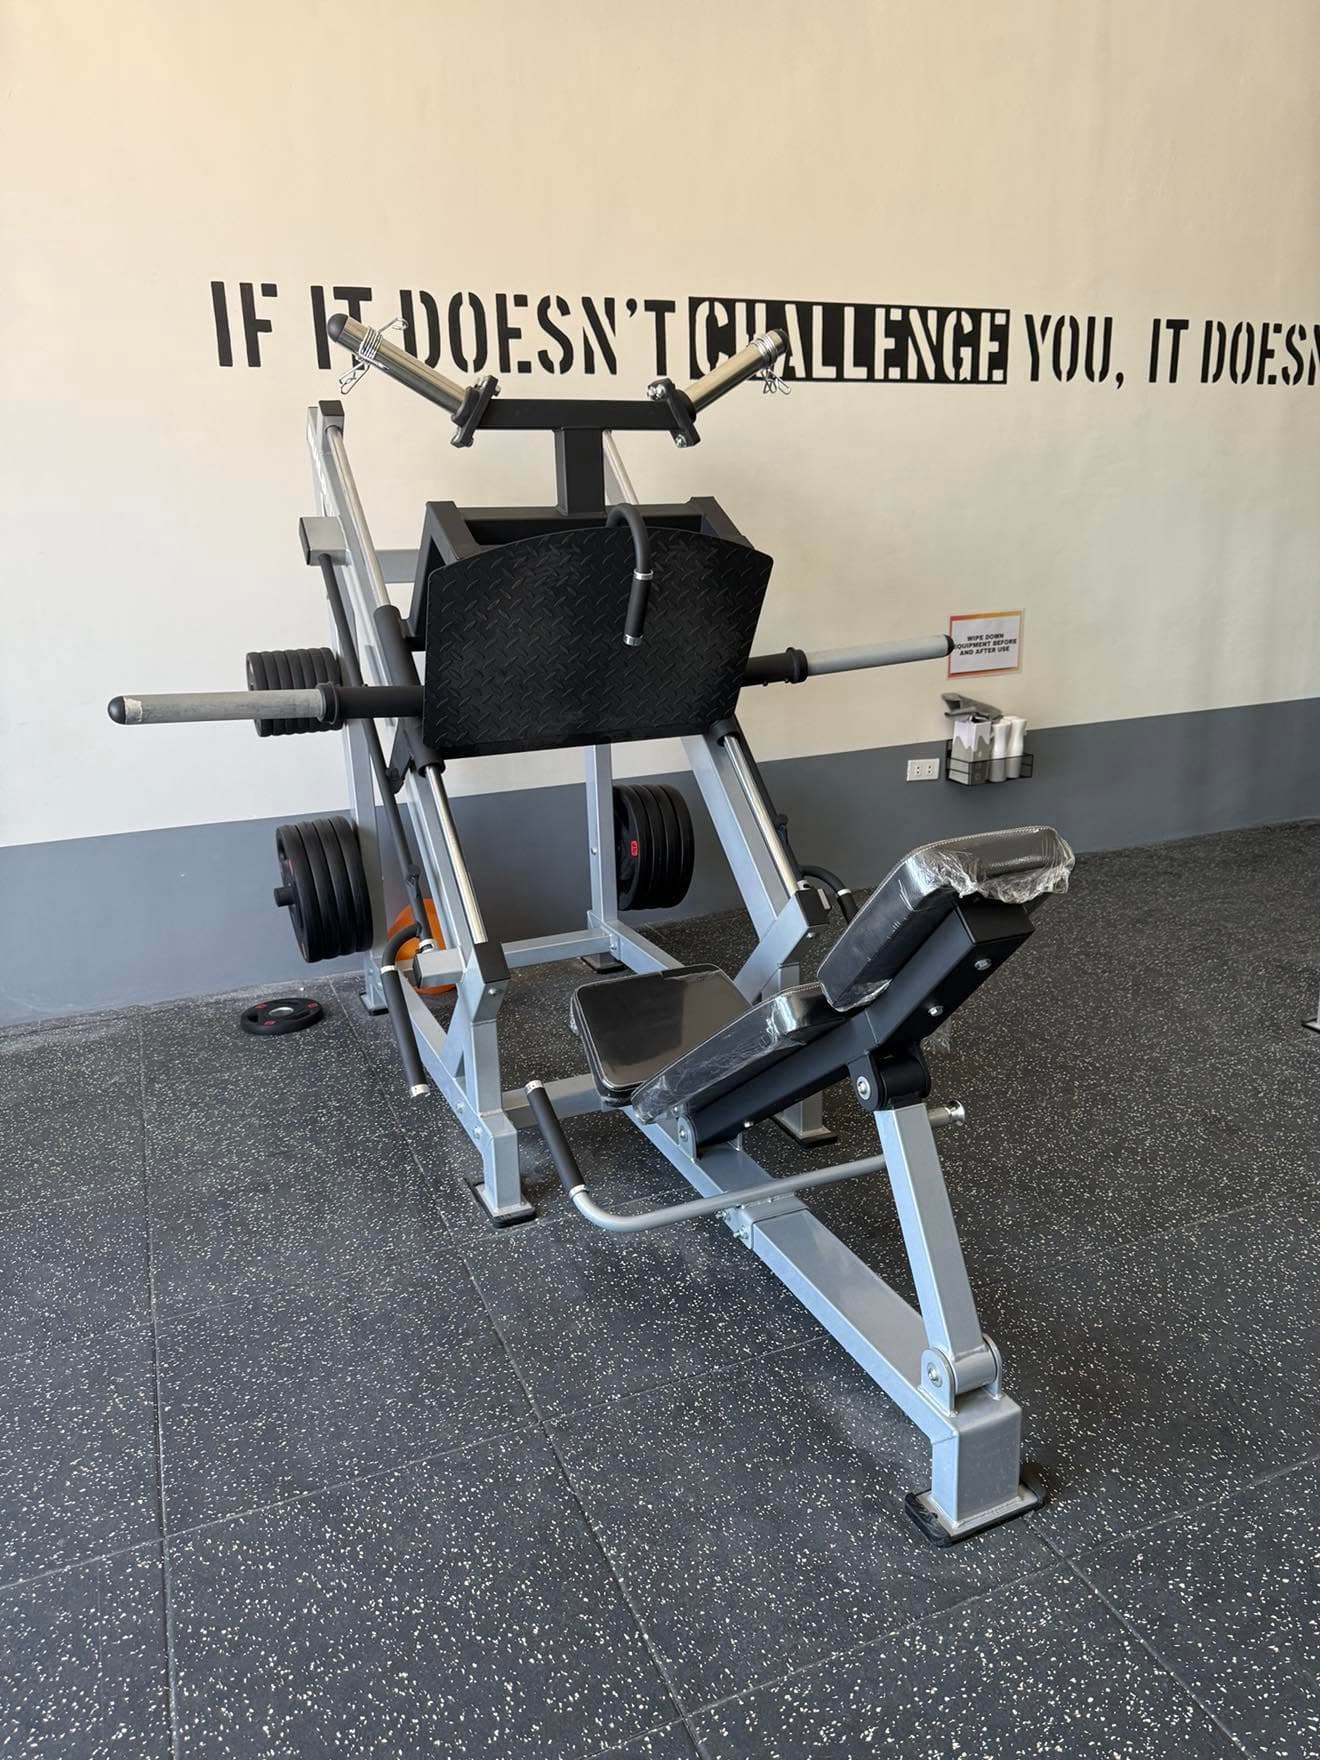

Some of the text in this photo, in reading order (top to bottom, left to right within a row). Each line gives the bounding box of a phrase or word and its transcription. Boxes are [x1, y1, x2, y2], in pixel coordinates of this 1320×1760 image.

[210, 280, 278, 367] IF
[310, 285, 373, 370] IT
[399, 289, 676, 376] DOESN'T
[694, 300, 1007, 382] CHALLENGE
[1024, 313, 1125, 390] YOU,
[1148, 318, 1190, 384] IT
[975, 647, 996, 655] AFTER
